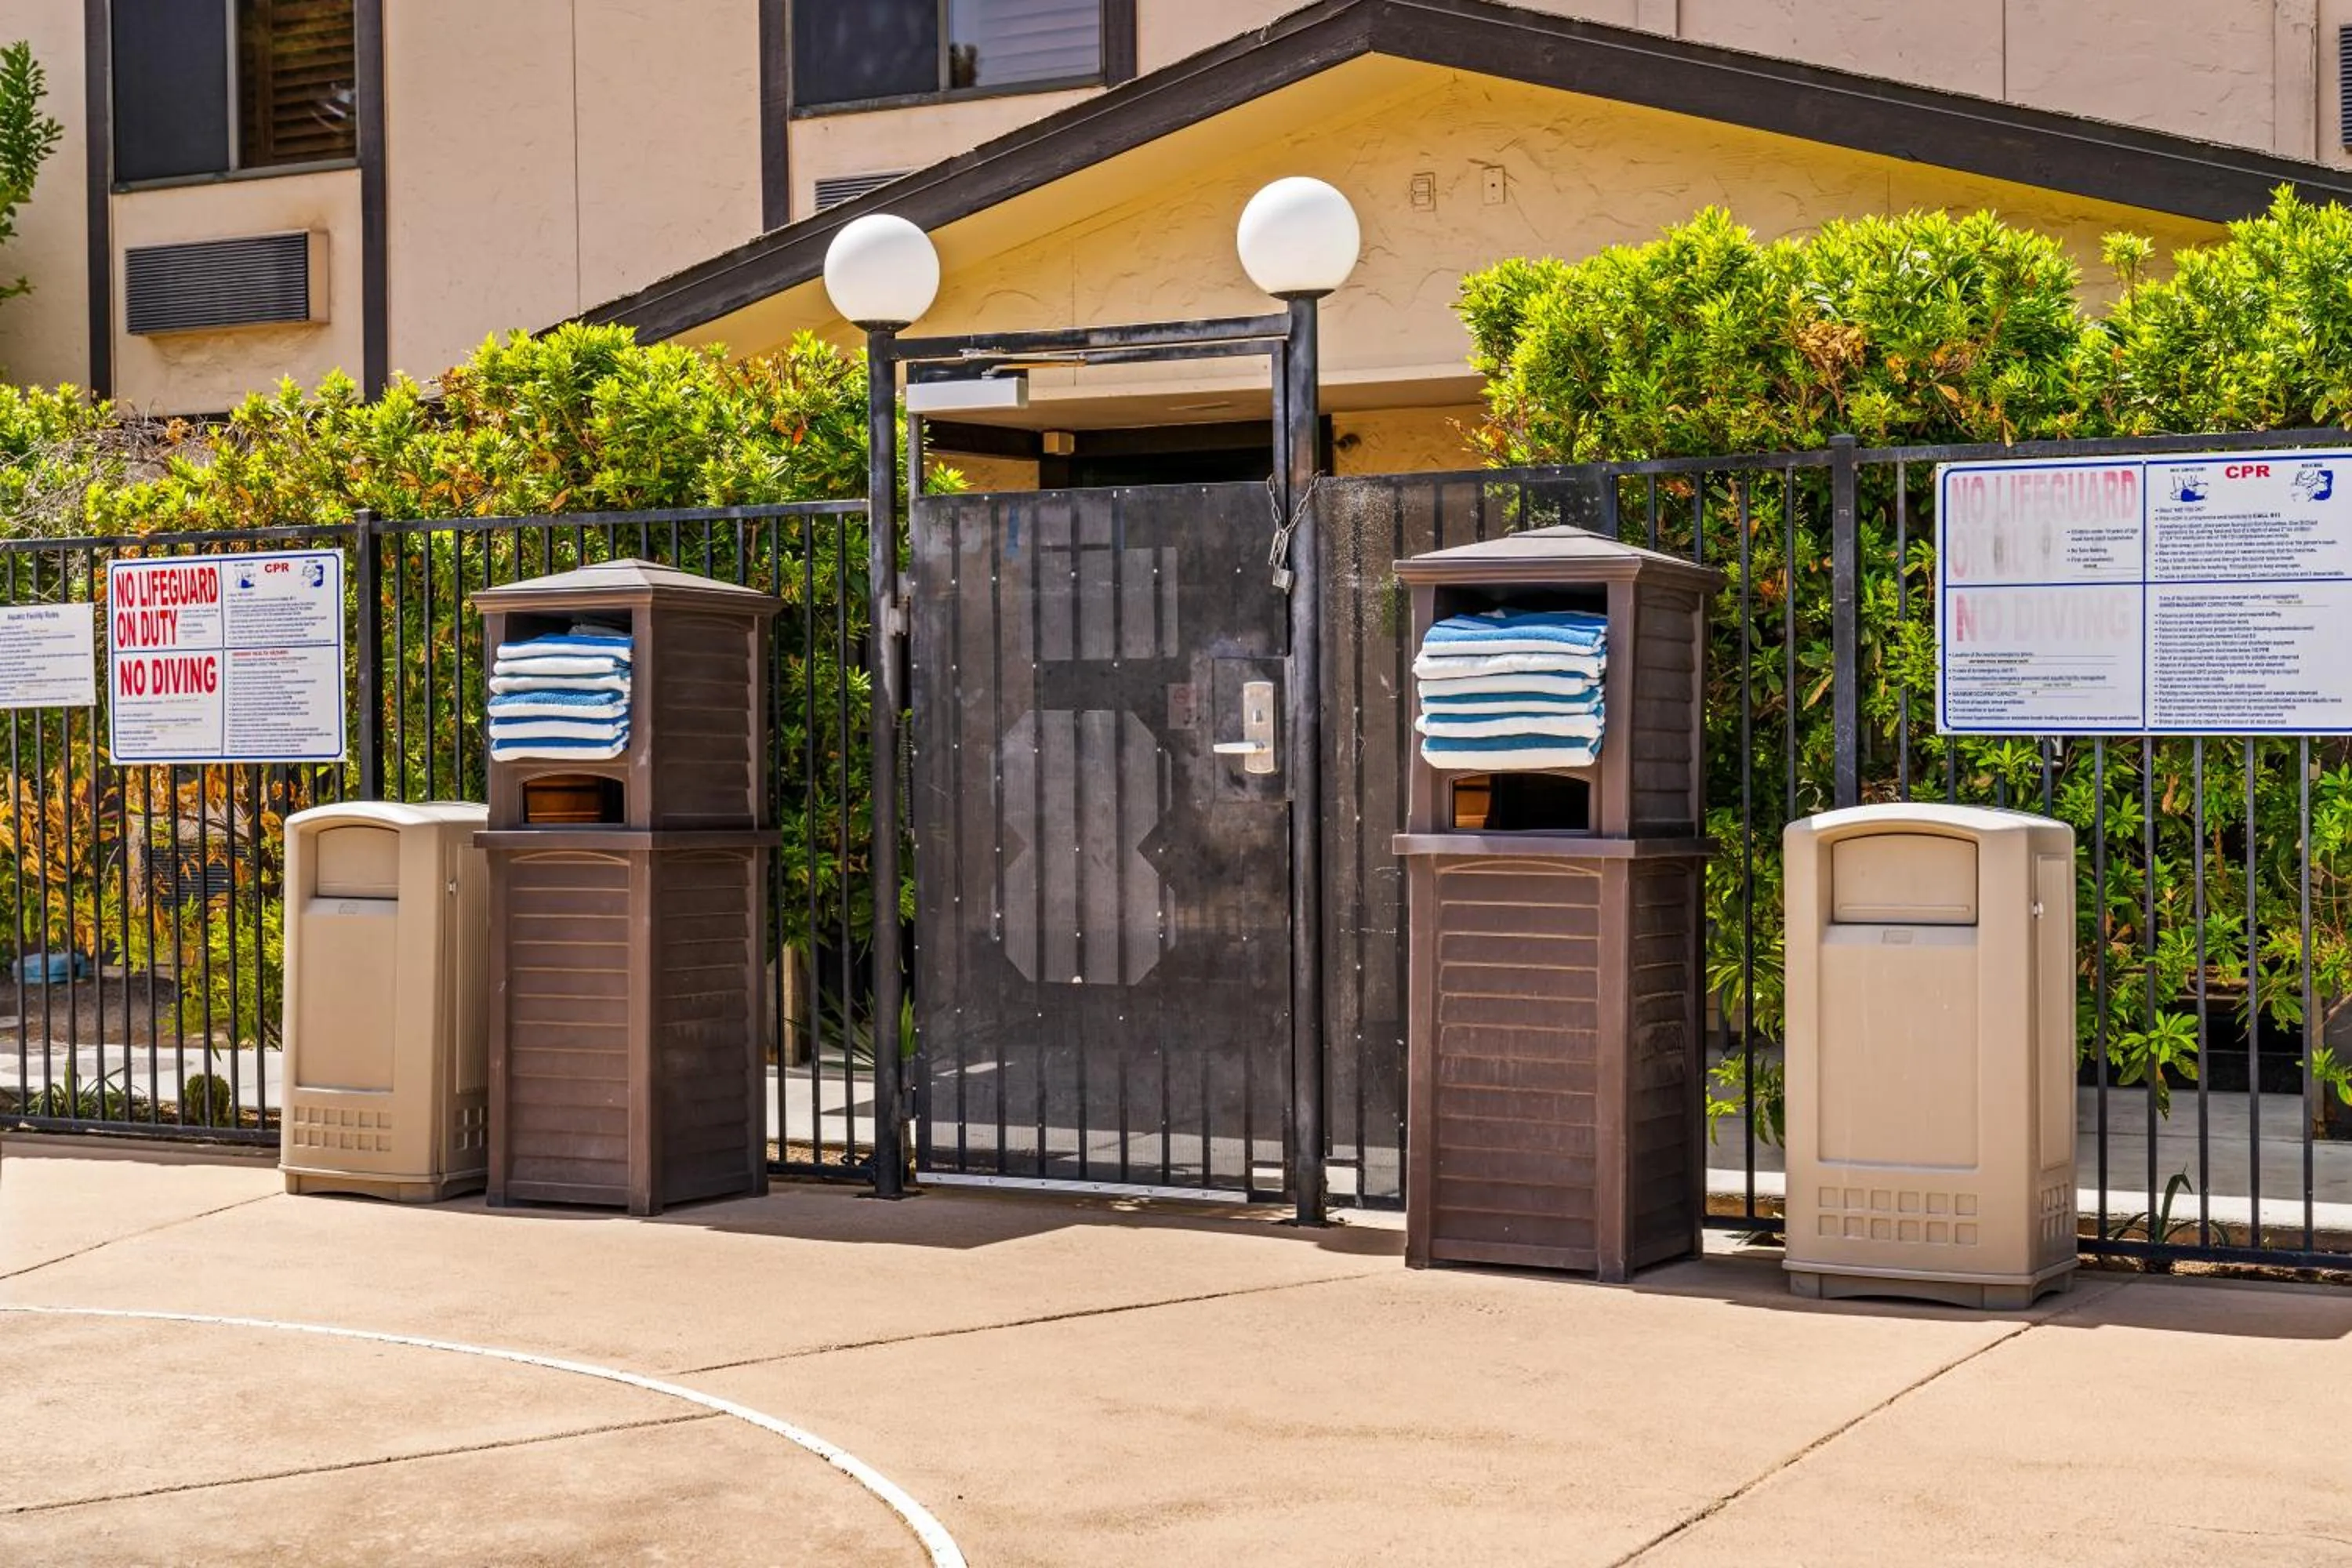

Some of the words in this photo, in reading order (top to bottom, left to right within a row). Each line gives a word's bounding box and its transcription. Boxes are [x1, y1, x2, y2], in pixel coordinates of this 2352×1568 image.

[2225, 465, 2270, 479] CPR
[1951, 476, 1985, 524] NO
[1995, 470, 2137, 522] LIFEGUARD
[264, 562, 289, 573] CPR
[116, 572, 135, 608] NO
[139, 568, 217, 607] LIFEGUARD
[117, 611, 136, 648] ON
[140, 609, 177, 646] DUTY
[120, 659, 146, 696] NO
[152, 656, 216, 694] DIVING
